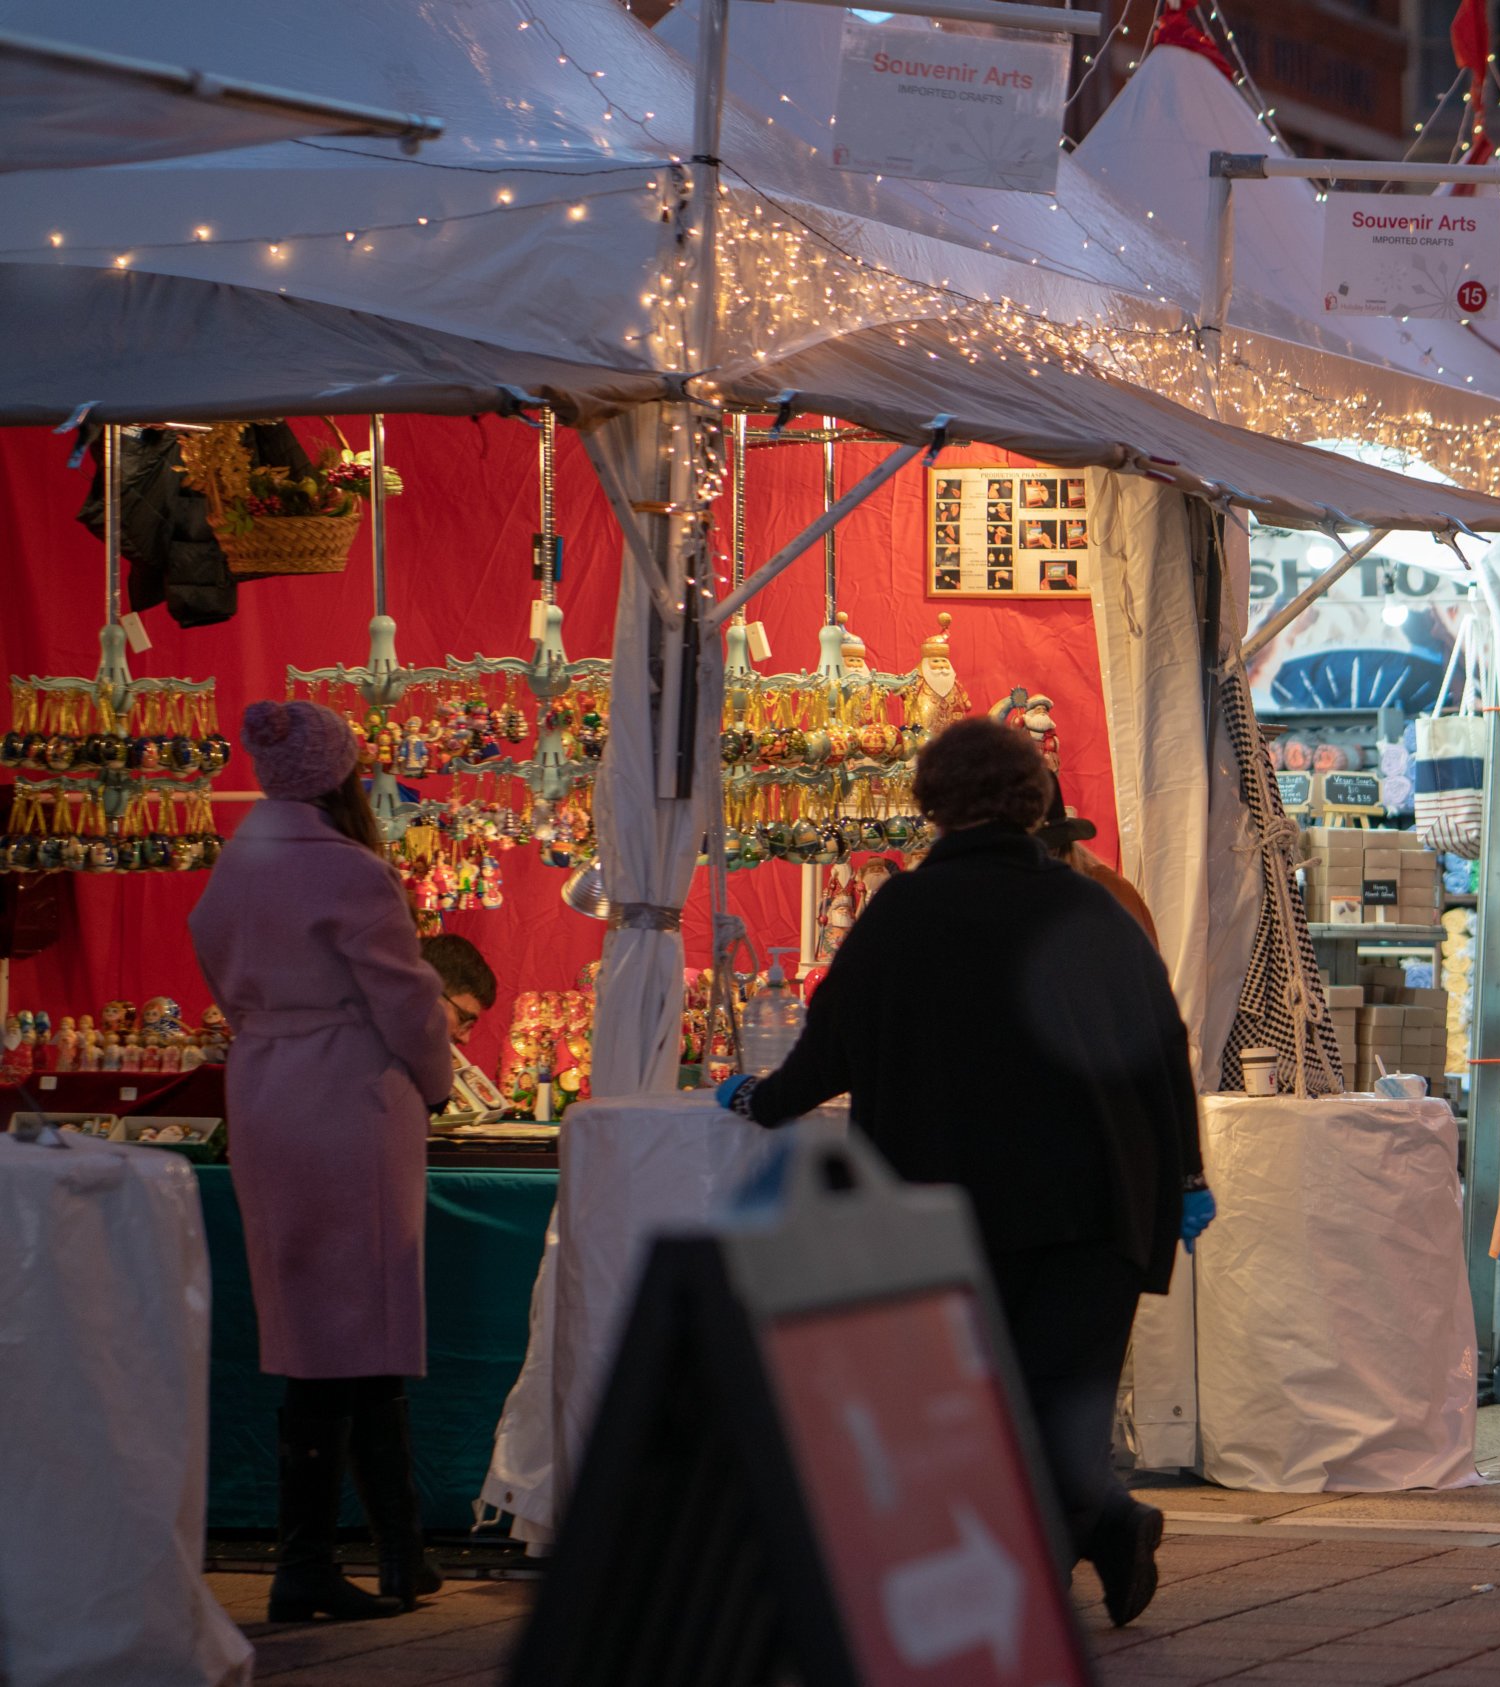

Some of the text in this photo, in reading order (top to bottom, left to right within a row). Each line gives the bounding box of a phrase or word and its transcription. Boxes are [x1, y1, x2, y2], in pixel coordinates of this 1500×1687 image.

[873, 52, 1033, 90] Souvenir Arts
[898, 84, 1003, 105] IMPORTED CRAFTS
[1352, 211, 1477, 232] Souvenir Arts
[1372, 235, 1454, 247] IMPORTED CRAFTS
[1462, 286, 1483, 305] 15
